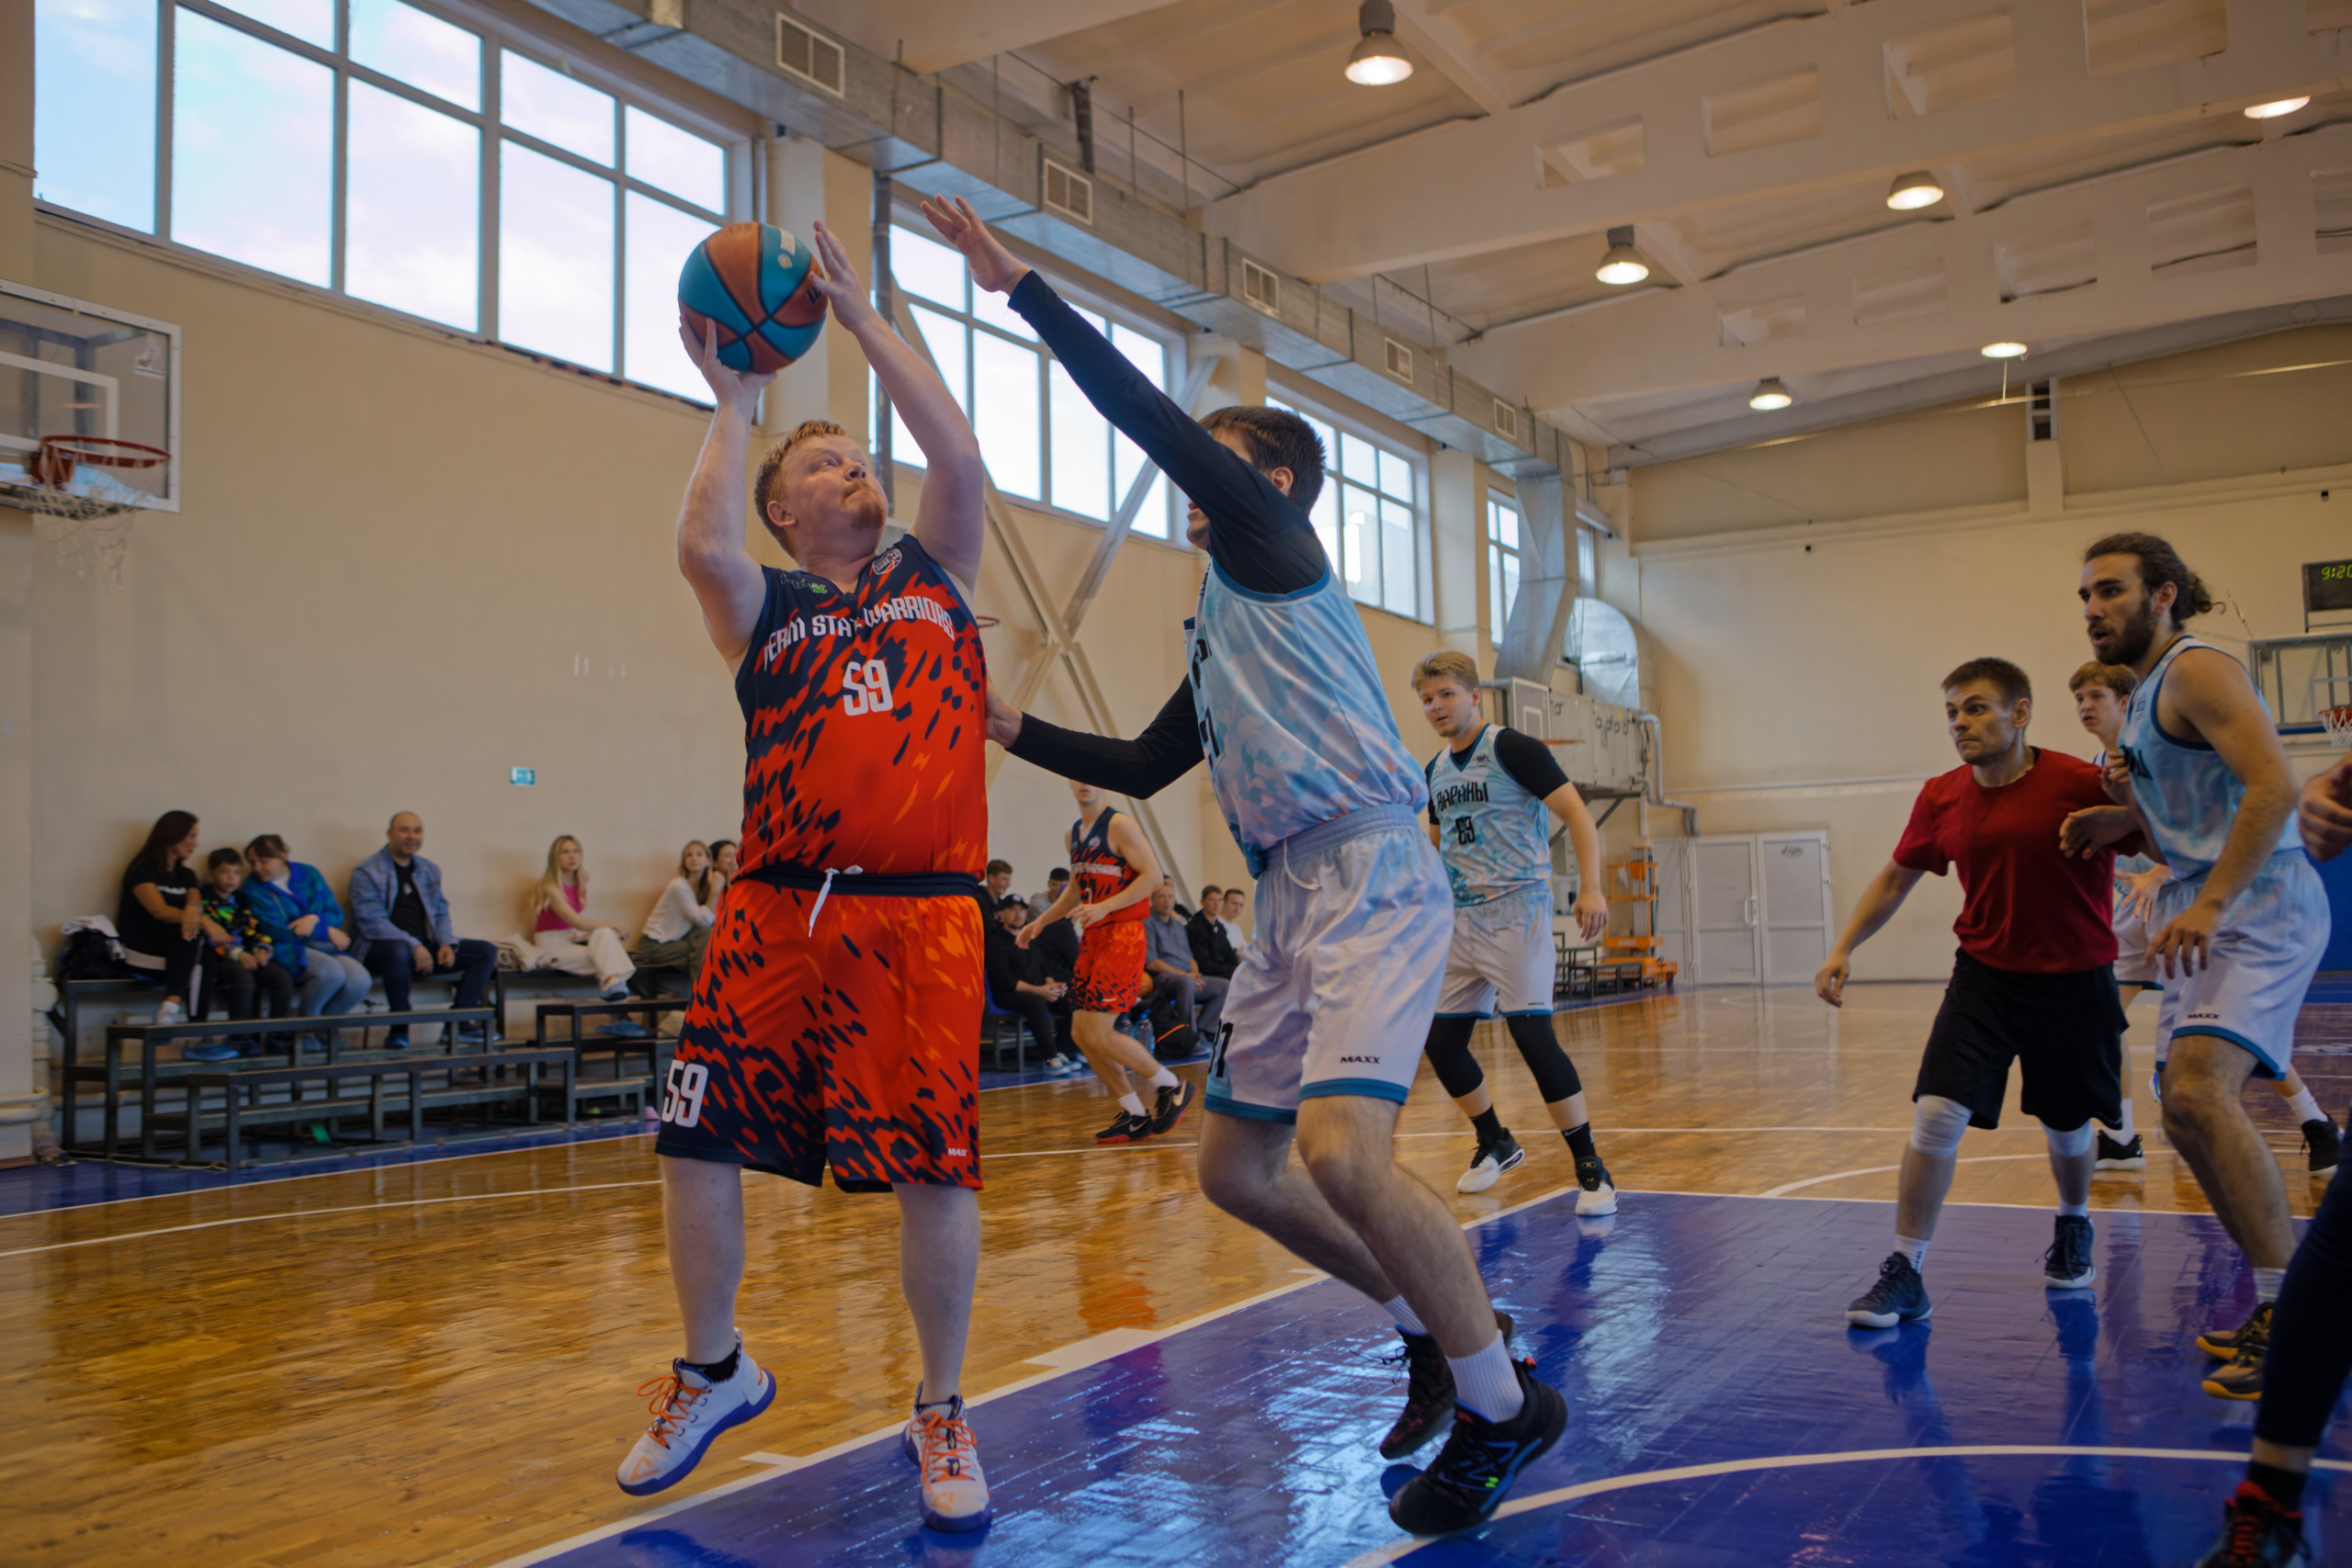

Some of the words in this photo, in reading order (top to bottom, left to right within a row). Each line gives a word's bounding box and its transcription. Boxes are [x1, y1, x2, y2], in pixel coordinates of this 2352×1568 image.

[863, 595, 955, 641] WARRIORS
[843, 659, 893, 716] 59
[1437, 782, 1489, 811] ВАРАНЫ
[1340, 1055, 1381, 1064] MAXX
[662, 1059, 708, 1128] 59
